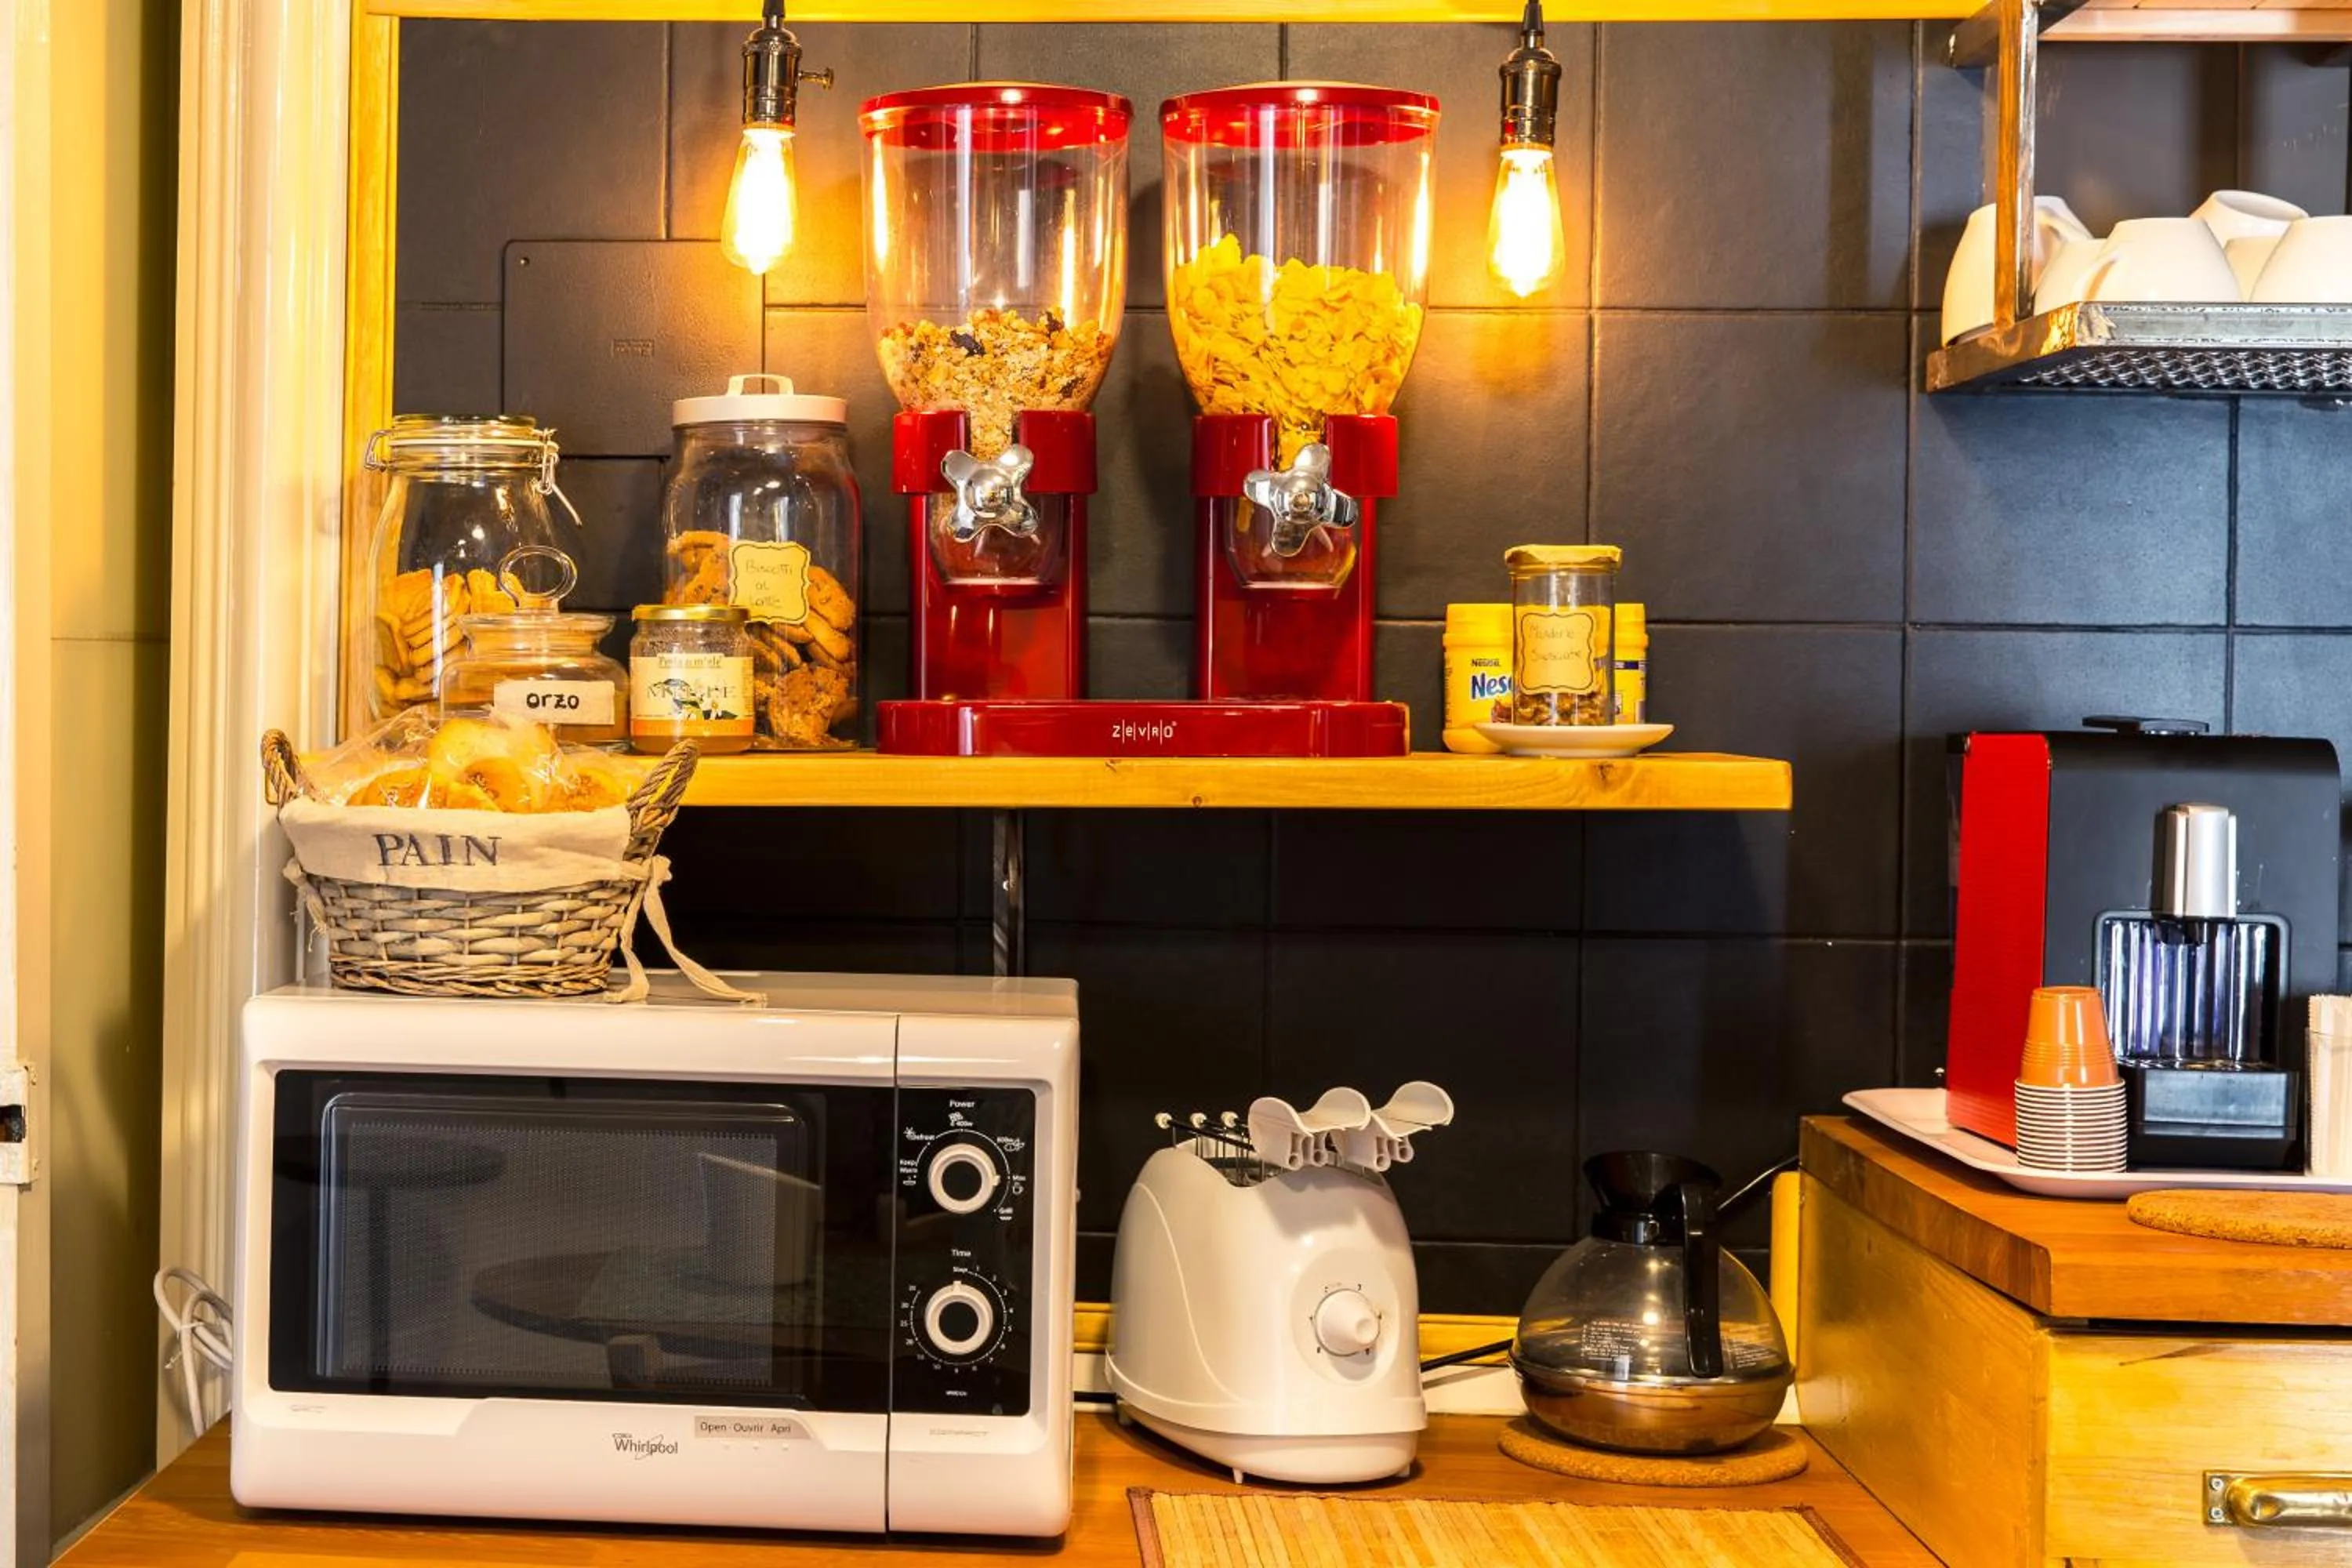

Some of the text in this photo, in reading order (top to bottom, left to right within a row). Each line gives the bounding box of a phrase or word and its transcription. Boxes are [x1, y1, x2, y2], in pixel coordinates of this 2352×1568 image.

[525, 693, 580, 710] orzo
[372, 833, 503, 866] PAIN
[949, 1099, 975, 1108] Power
[700, 1421, 791, 1434] Open Ouvrir Apri
[614, 1438, 678, 1456] Whirlpool
